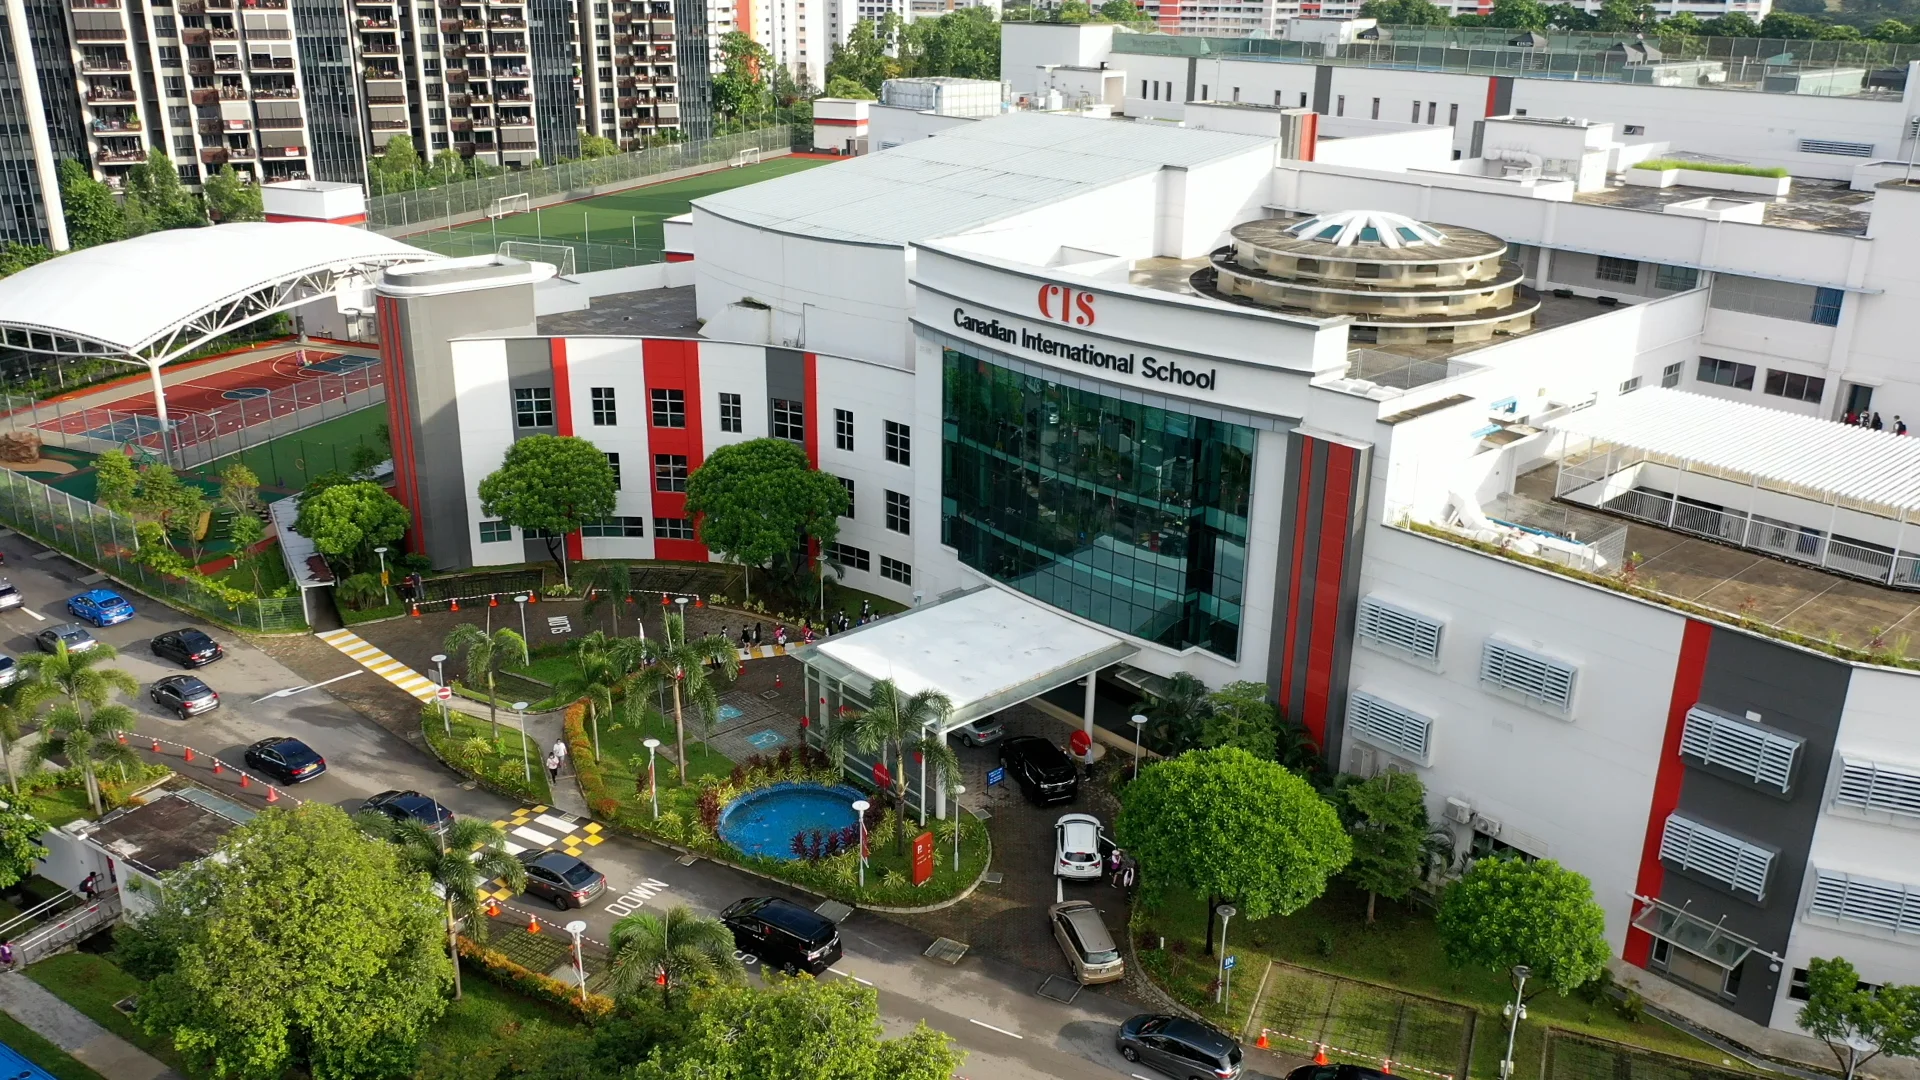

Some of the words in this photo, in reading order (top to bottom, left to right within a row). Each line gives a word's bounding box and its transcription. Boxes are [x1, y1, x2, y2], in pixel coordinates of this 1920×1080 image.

[1038, 283, 1095, 327] CIS
[953, 307, 1017, 345] Canadian
[1021, 328, 1135, 375] International
[1141, 356, 1216, 391] School
[604, 878, 669, 917] DOWN
[1225, 956, 1233, 966] IN
